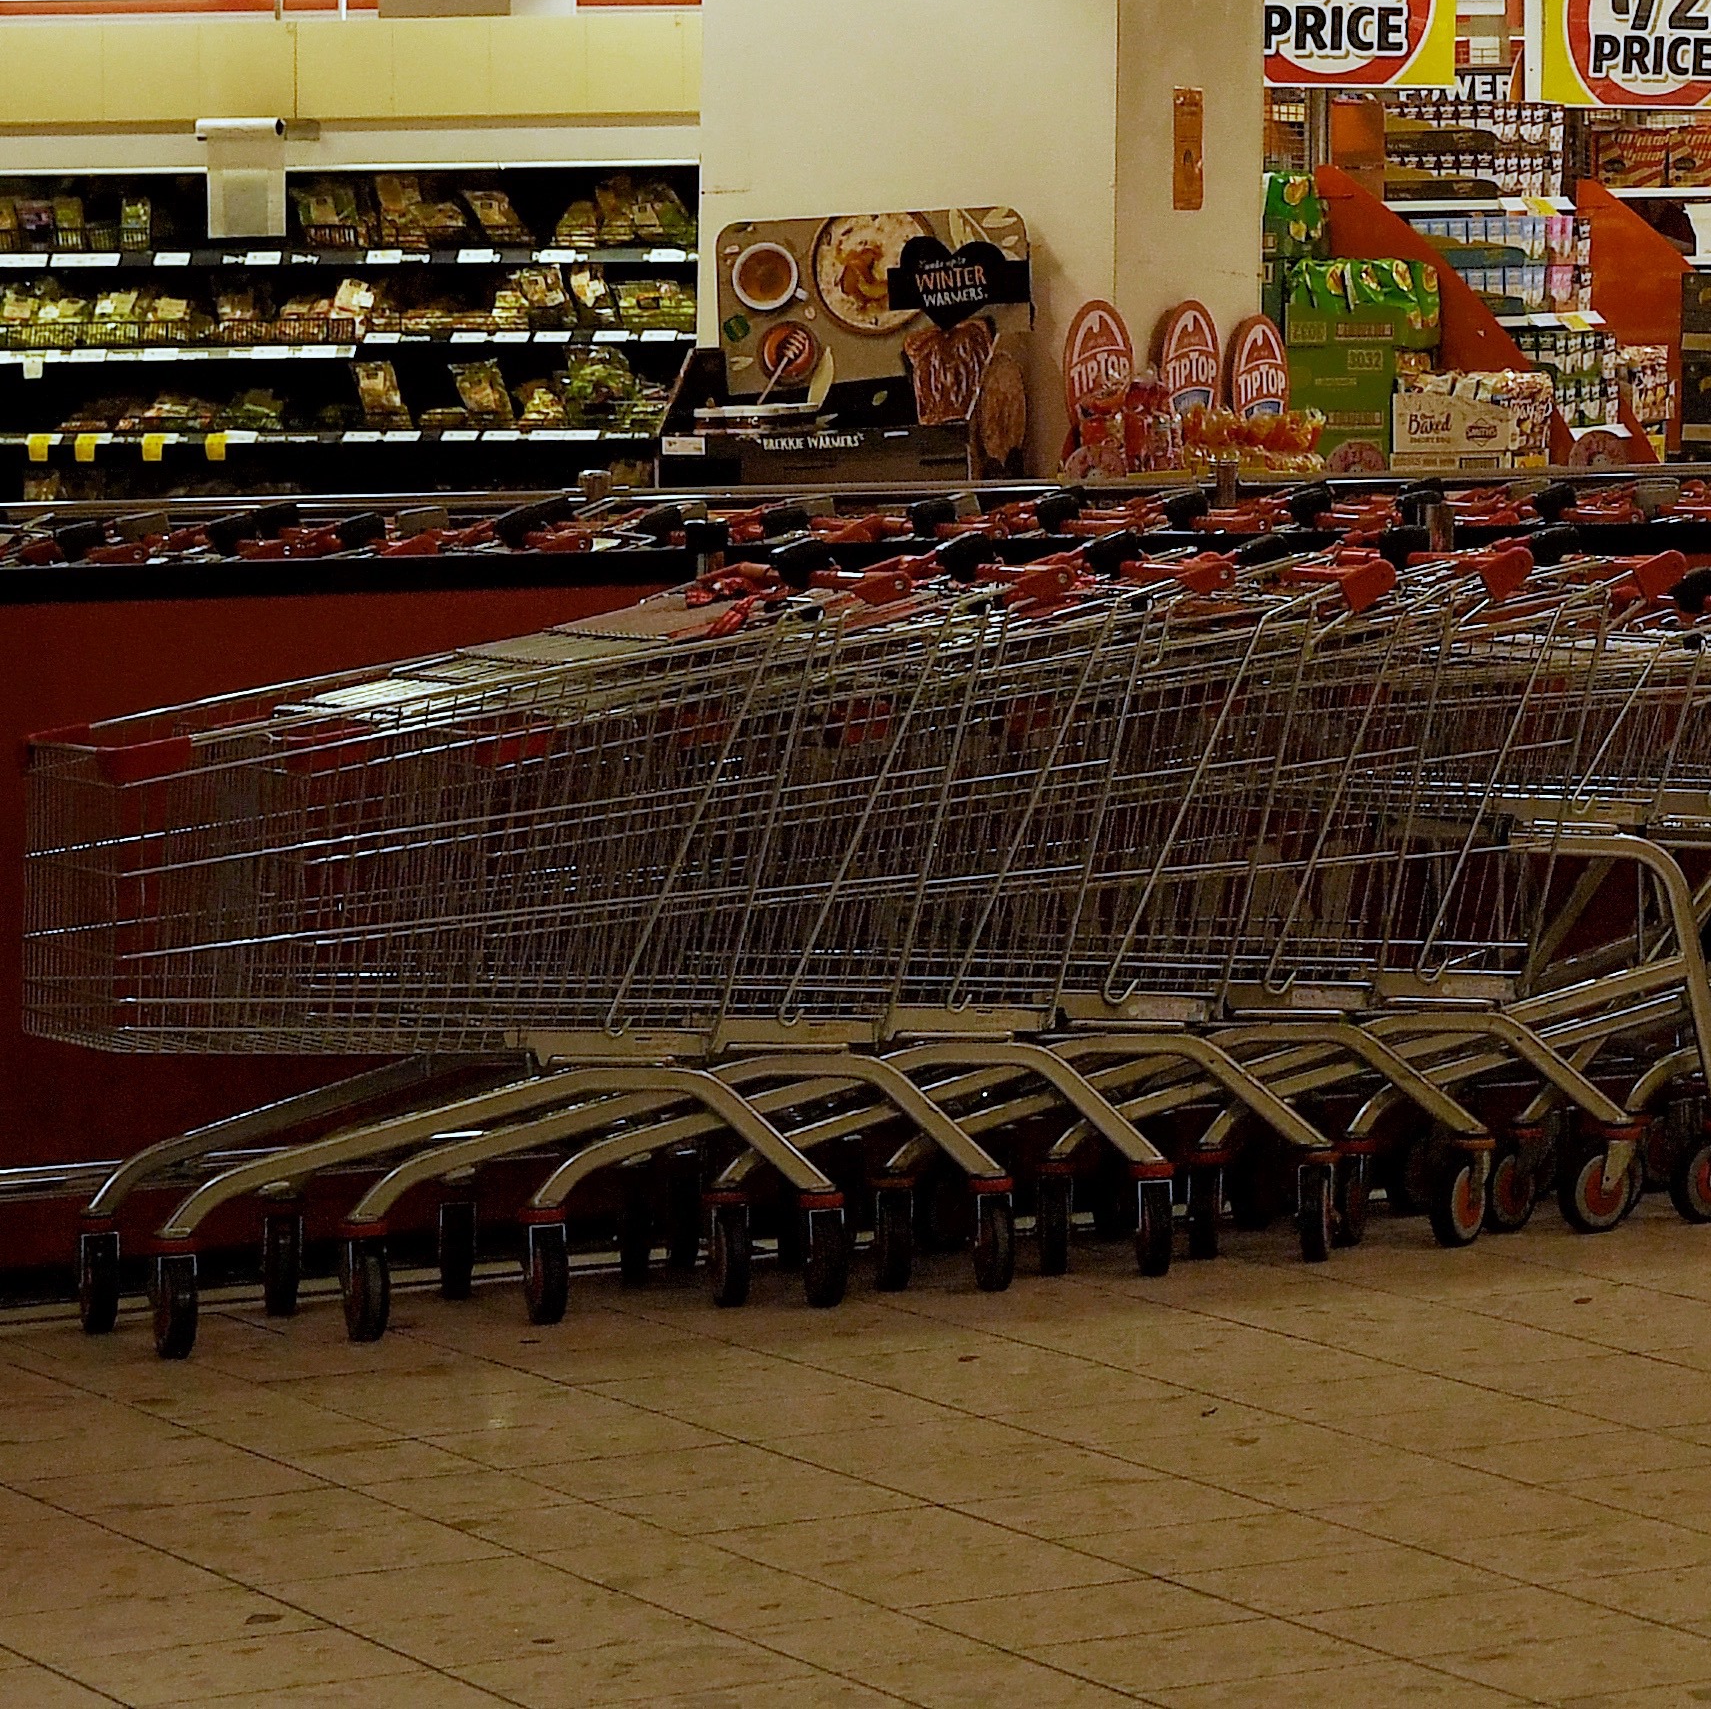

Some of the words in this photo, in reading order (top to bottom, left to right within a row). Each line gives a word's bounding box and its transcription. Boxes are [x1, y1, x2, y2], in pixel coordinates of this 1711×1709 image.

[1265, 5, 1405, 52] PRICE
[916, 265, 988, 292] WINTER
[1407, 412, 1453, 436] Baked
